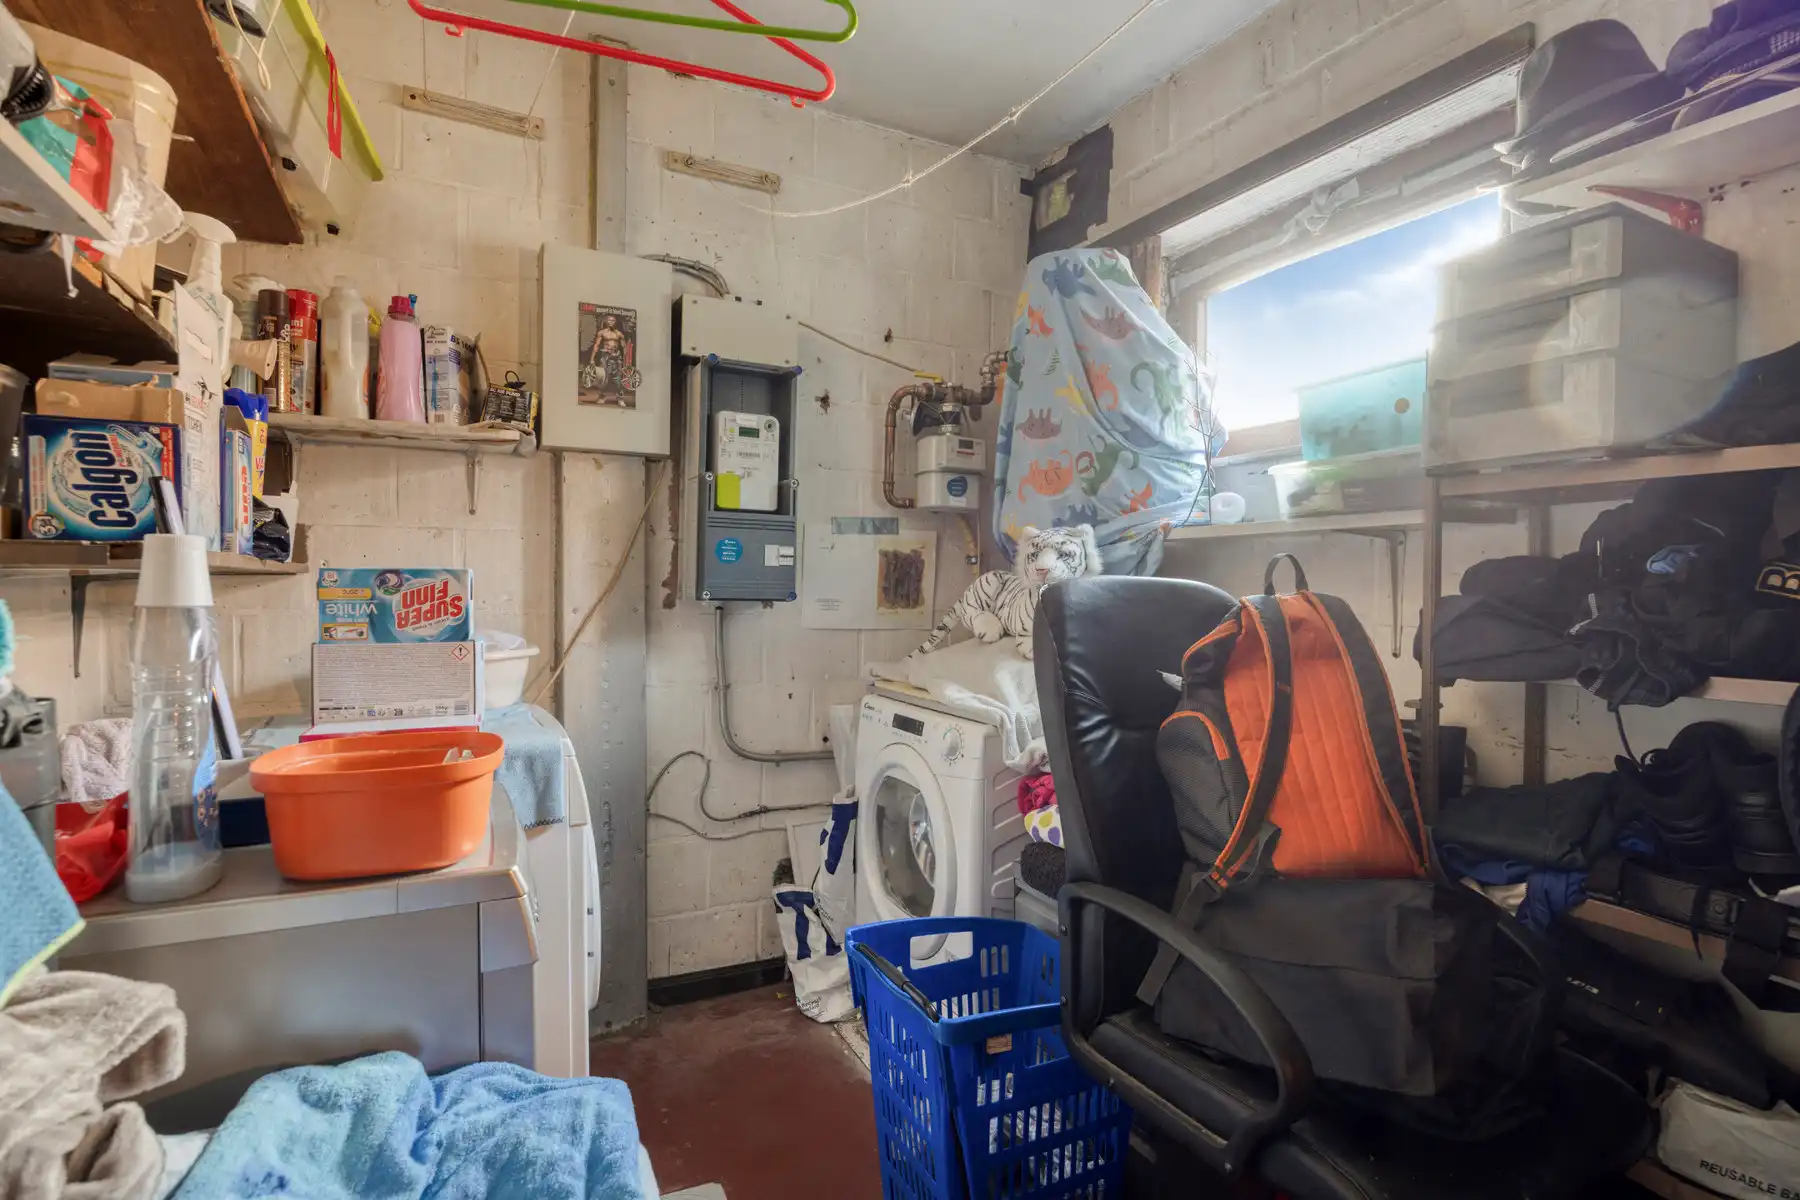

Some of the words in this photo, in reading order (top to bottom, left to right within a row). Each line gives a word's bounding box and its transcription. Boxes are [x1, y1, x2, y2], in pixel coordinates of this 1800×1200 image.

[69, 429, 138, 528] Calgon
[325, 602, 378, 616] white
[396, 595, 464, 631] SUPER
[1700, 1160, 1777, 1195] REUSABLE
